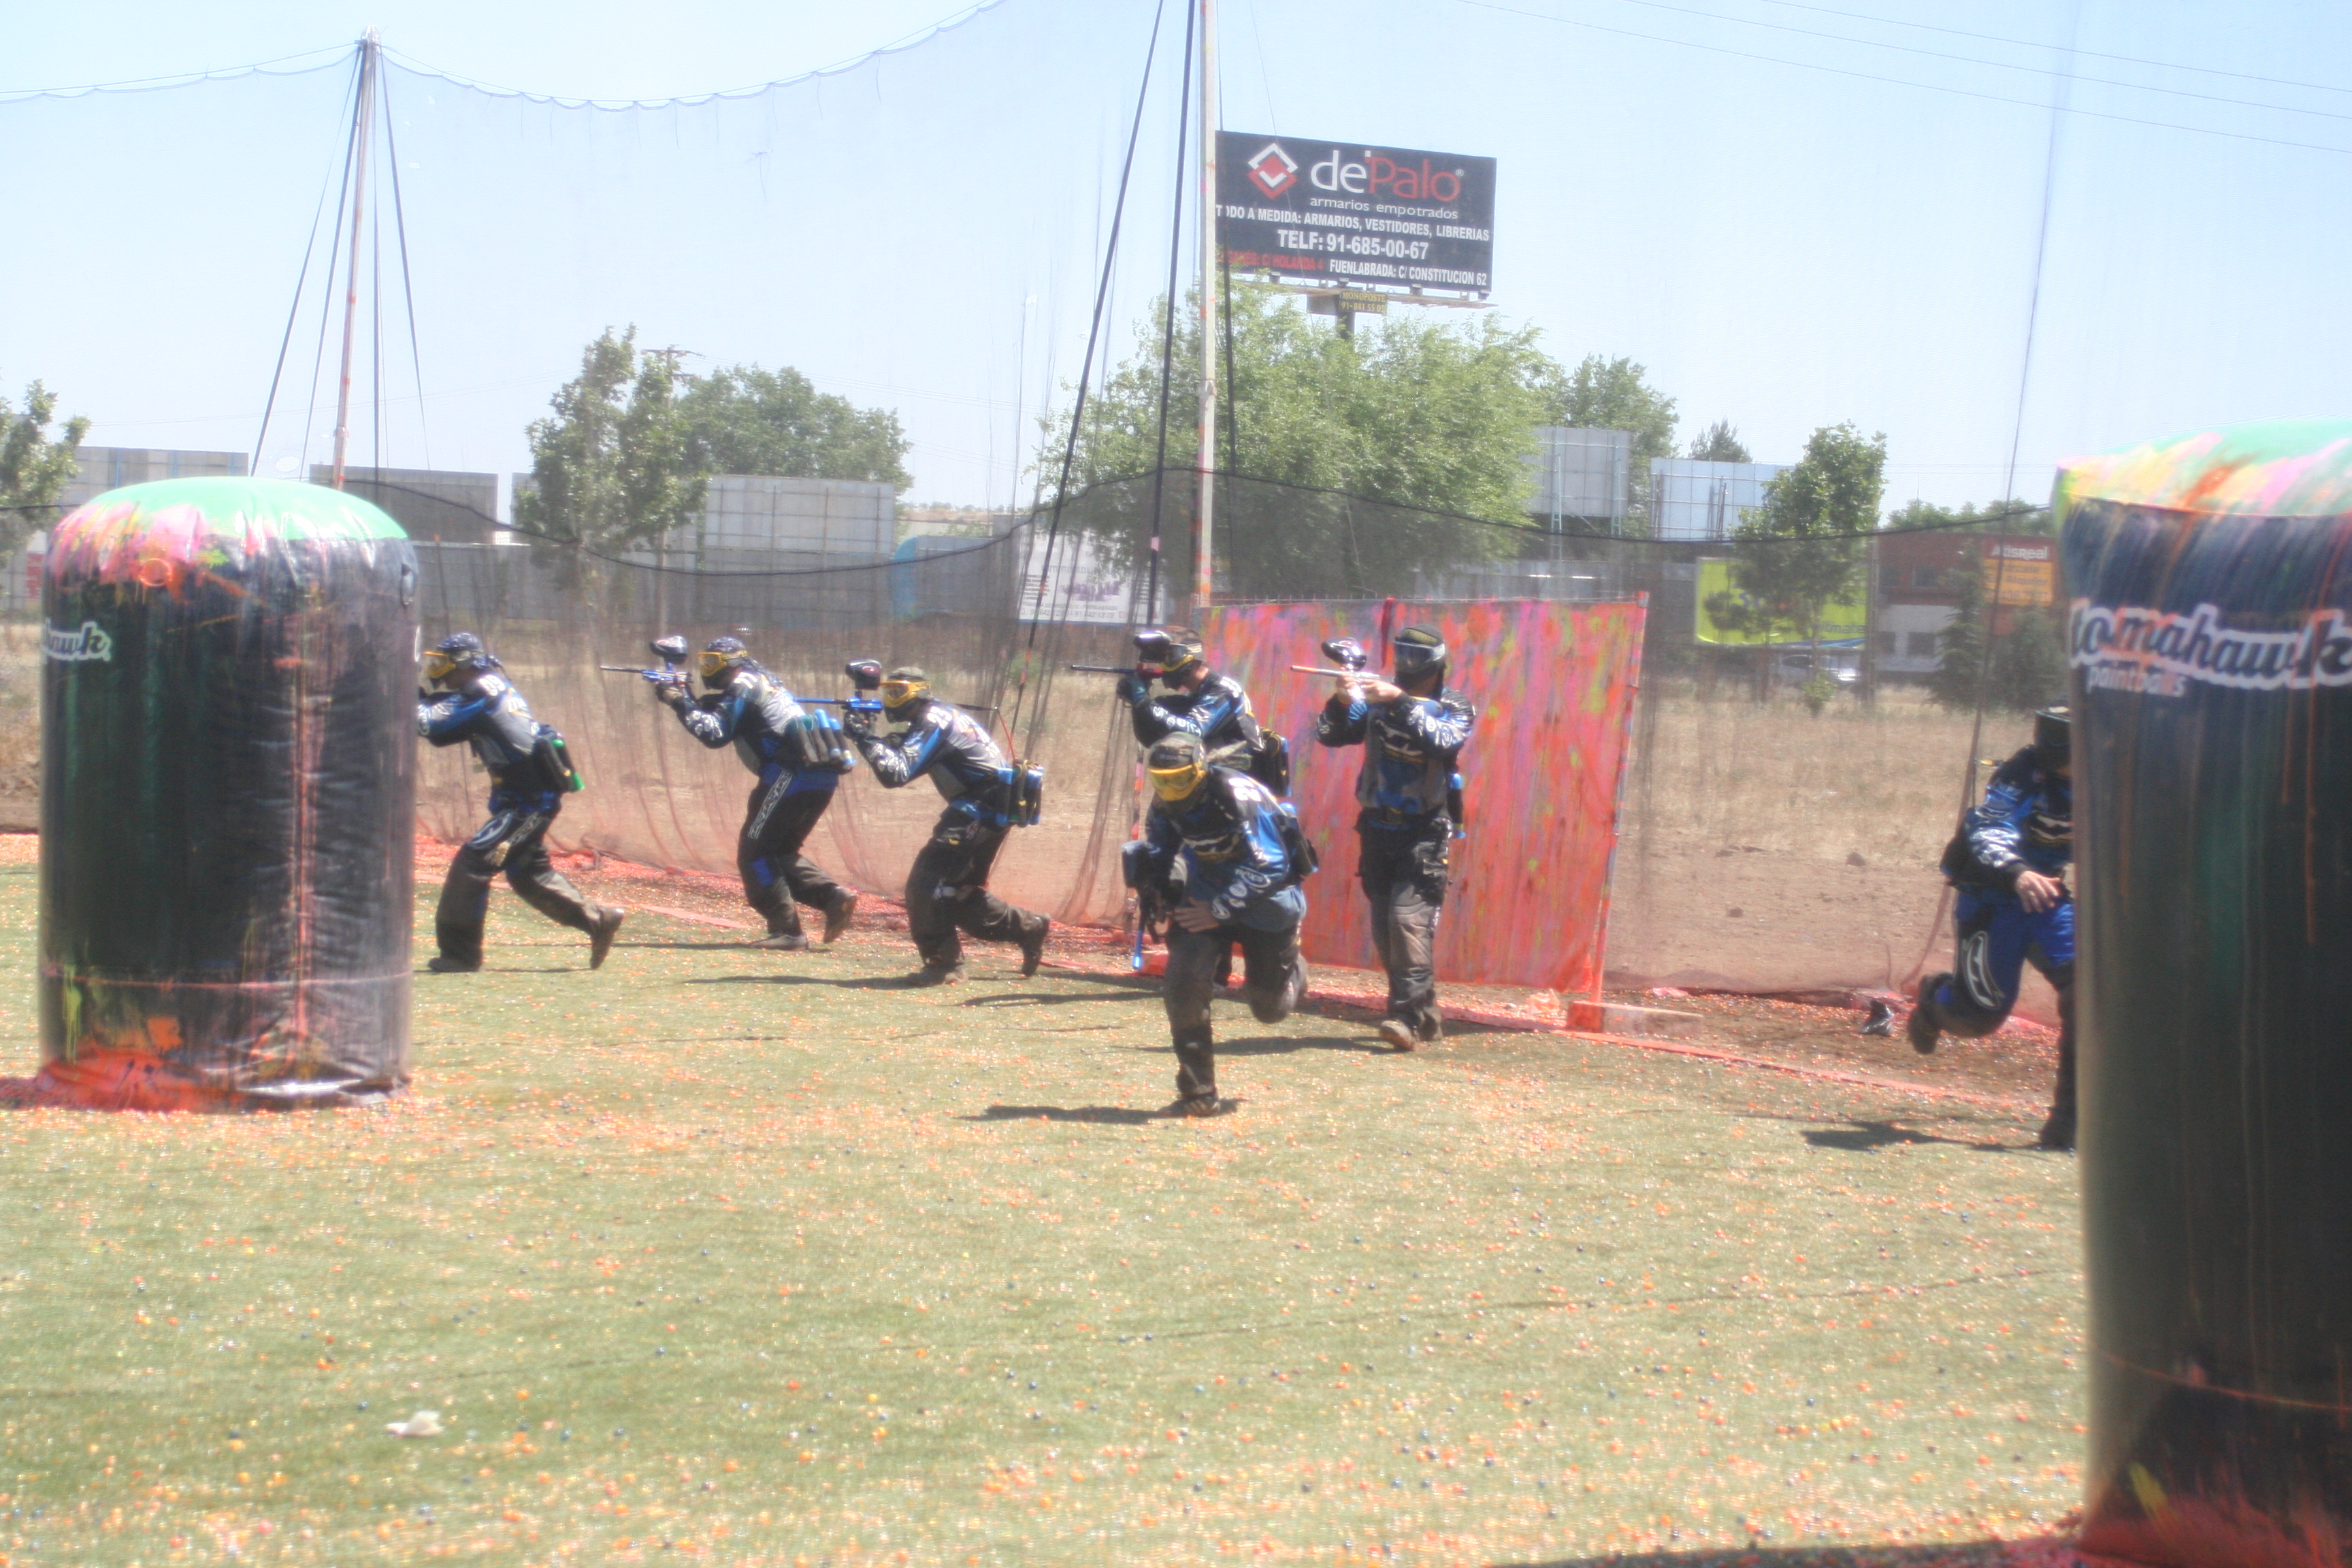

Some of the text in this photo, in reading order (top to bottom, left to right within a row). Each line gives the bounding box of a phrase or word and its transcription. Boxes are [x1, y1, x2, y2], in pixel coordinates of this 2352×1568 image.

[1309, 197, 1458, 220] armarios empotrados
[1247, 208, 1255, 220] A
[1258, 208, 1301, 224] MEDIDA:
[1304, 212, 1362, 233] ARMARIOS,
[1365, 218, 1432, 239] VESTIDORES,
[1436, 225, 1490, 242] LIBRERIAS
[1277, 229, 1428, 260] TELF: 91-685-00-67
[1330, 259, 1487, 286] FUENLABRADA: C/ CONSTITUCION 62
[1342, 291, 1386, 302] MONOPOSTE
